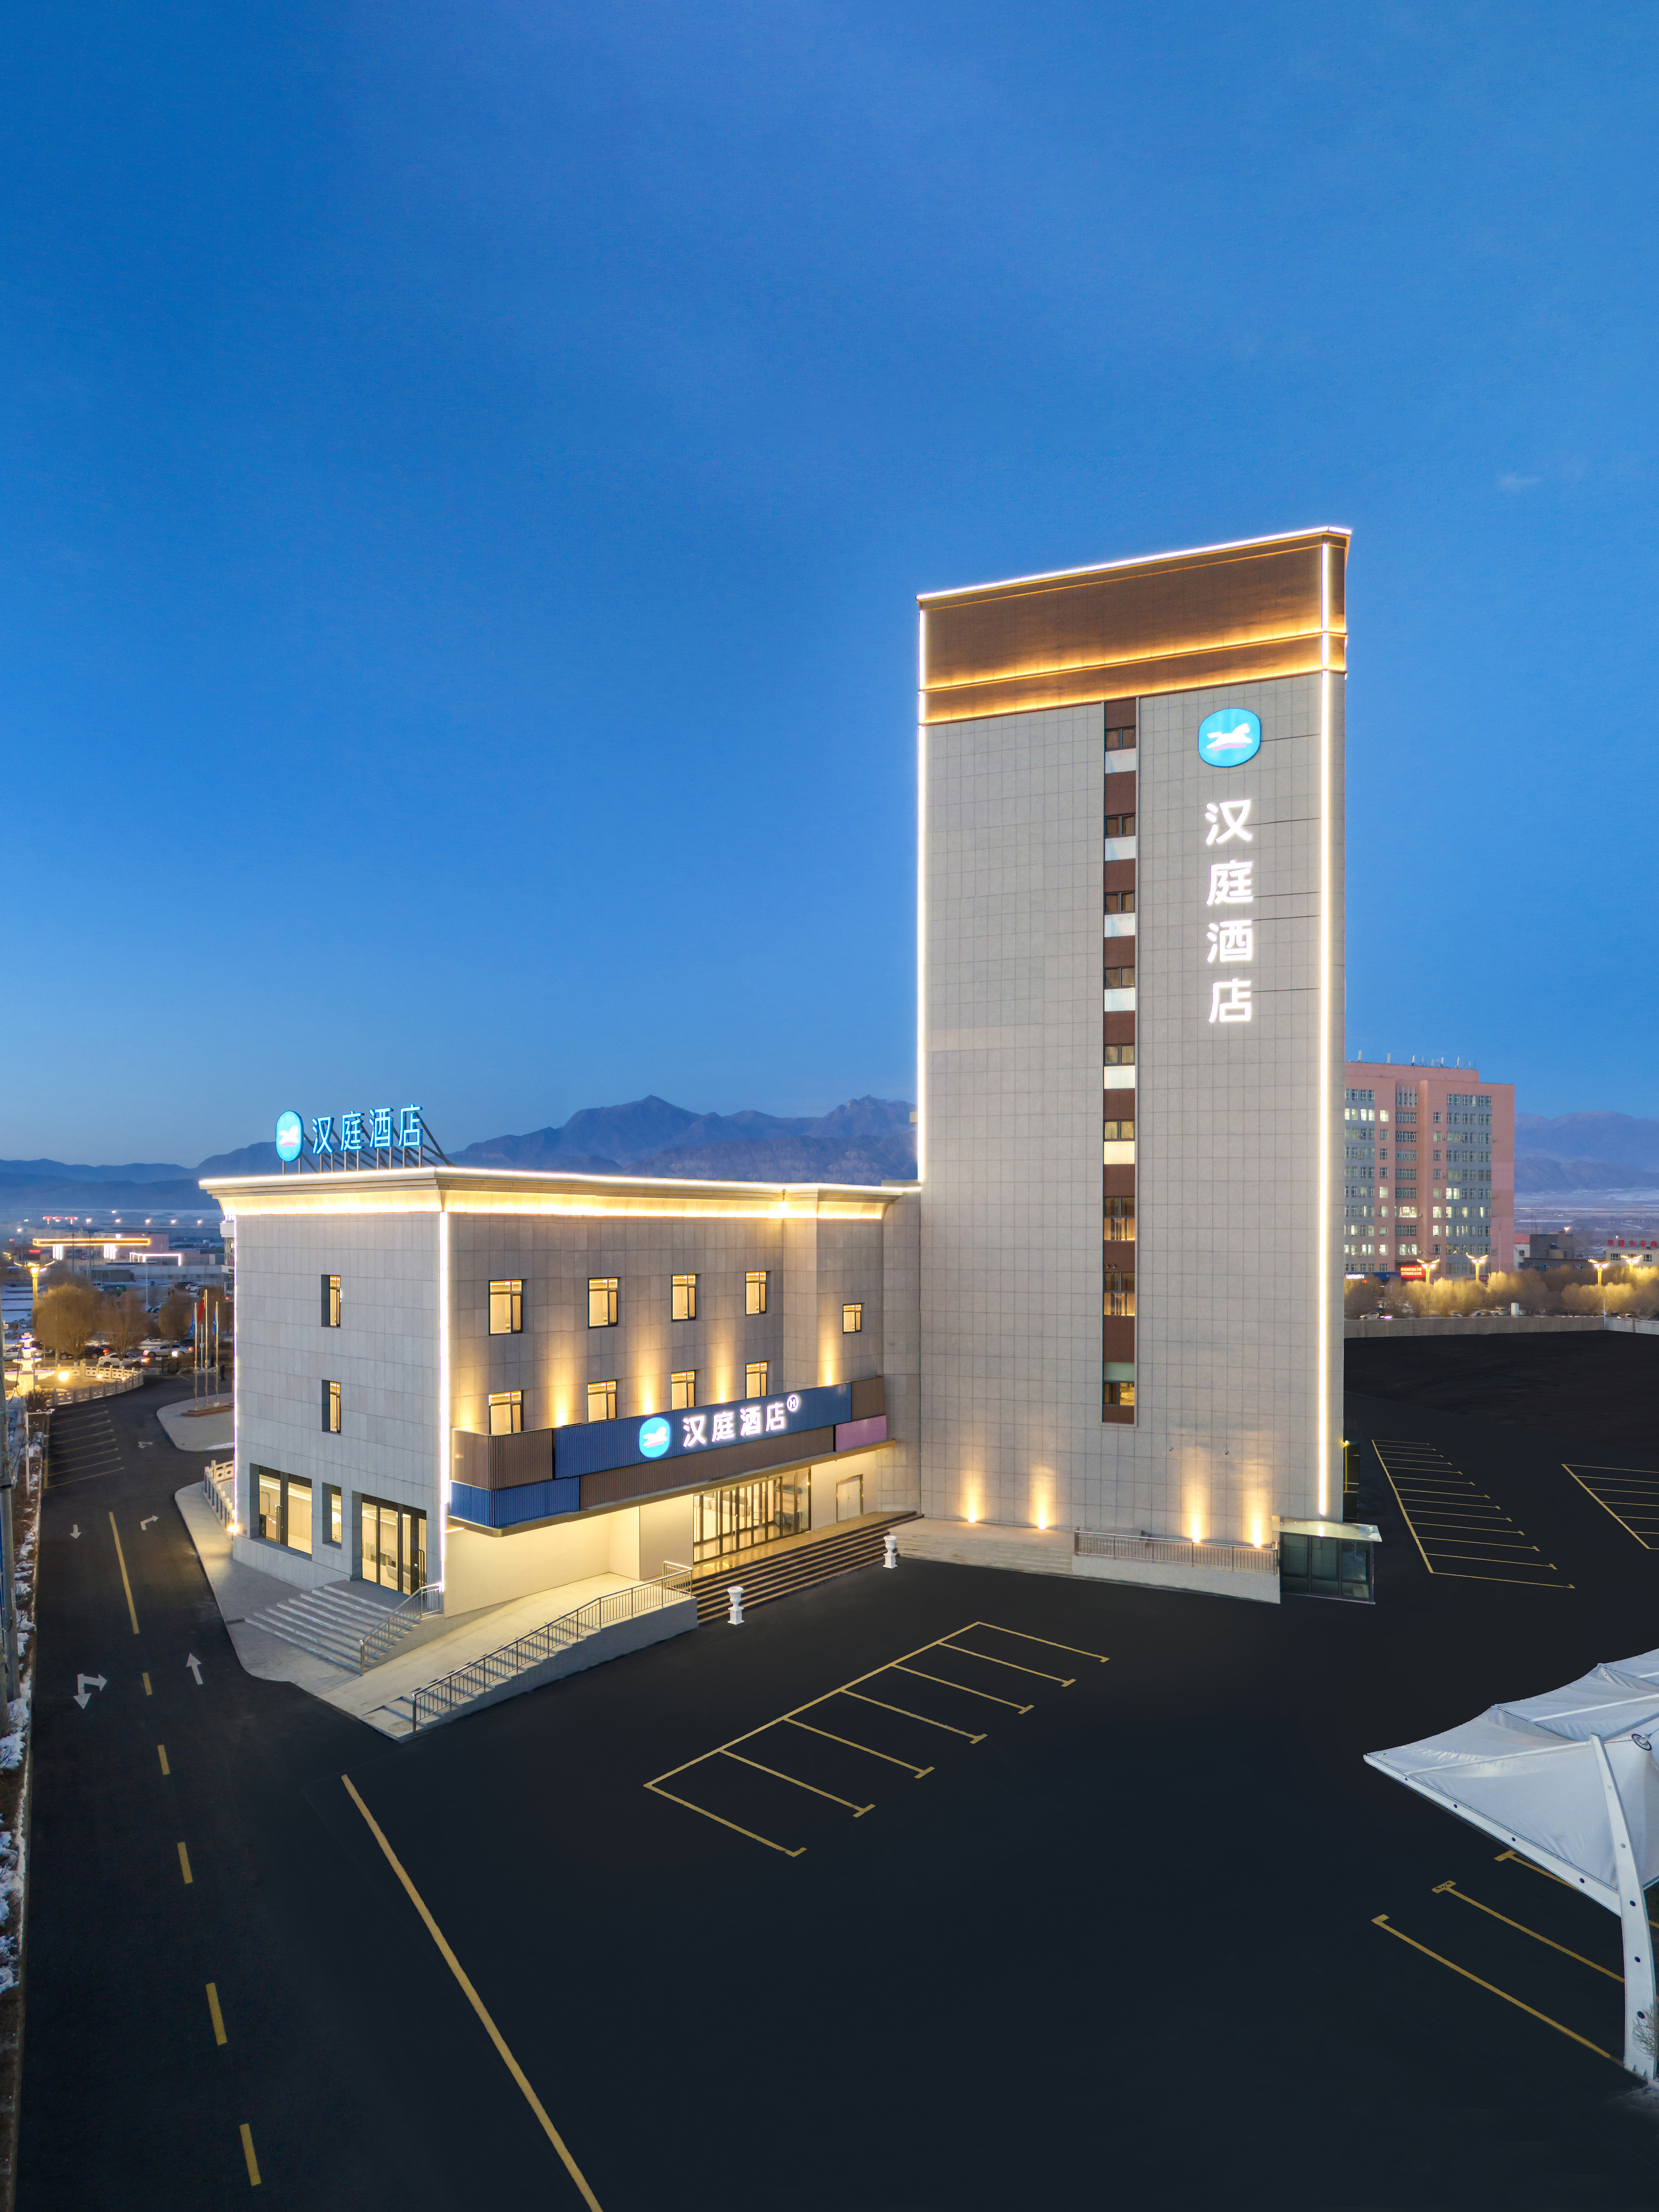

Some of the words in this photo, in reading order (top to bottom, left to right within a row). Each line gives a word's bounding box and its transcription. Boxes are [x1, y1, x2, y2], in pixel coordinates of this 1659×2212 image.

[1204, 799, 1253, 1023] 汉庭酒店
[312, 1103, 422, 1155] 汉庭酒店
[683, 1402, 784, 1447] 汉庭酒店
